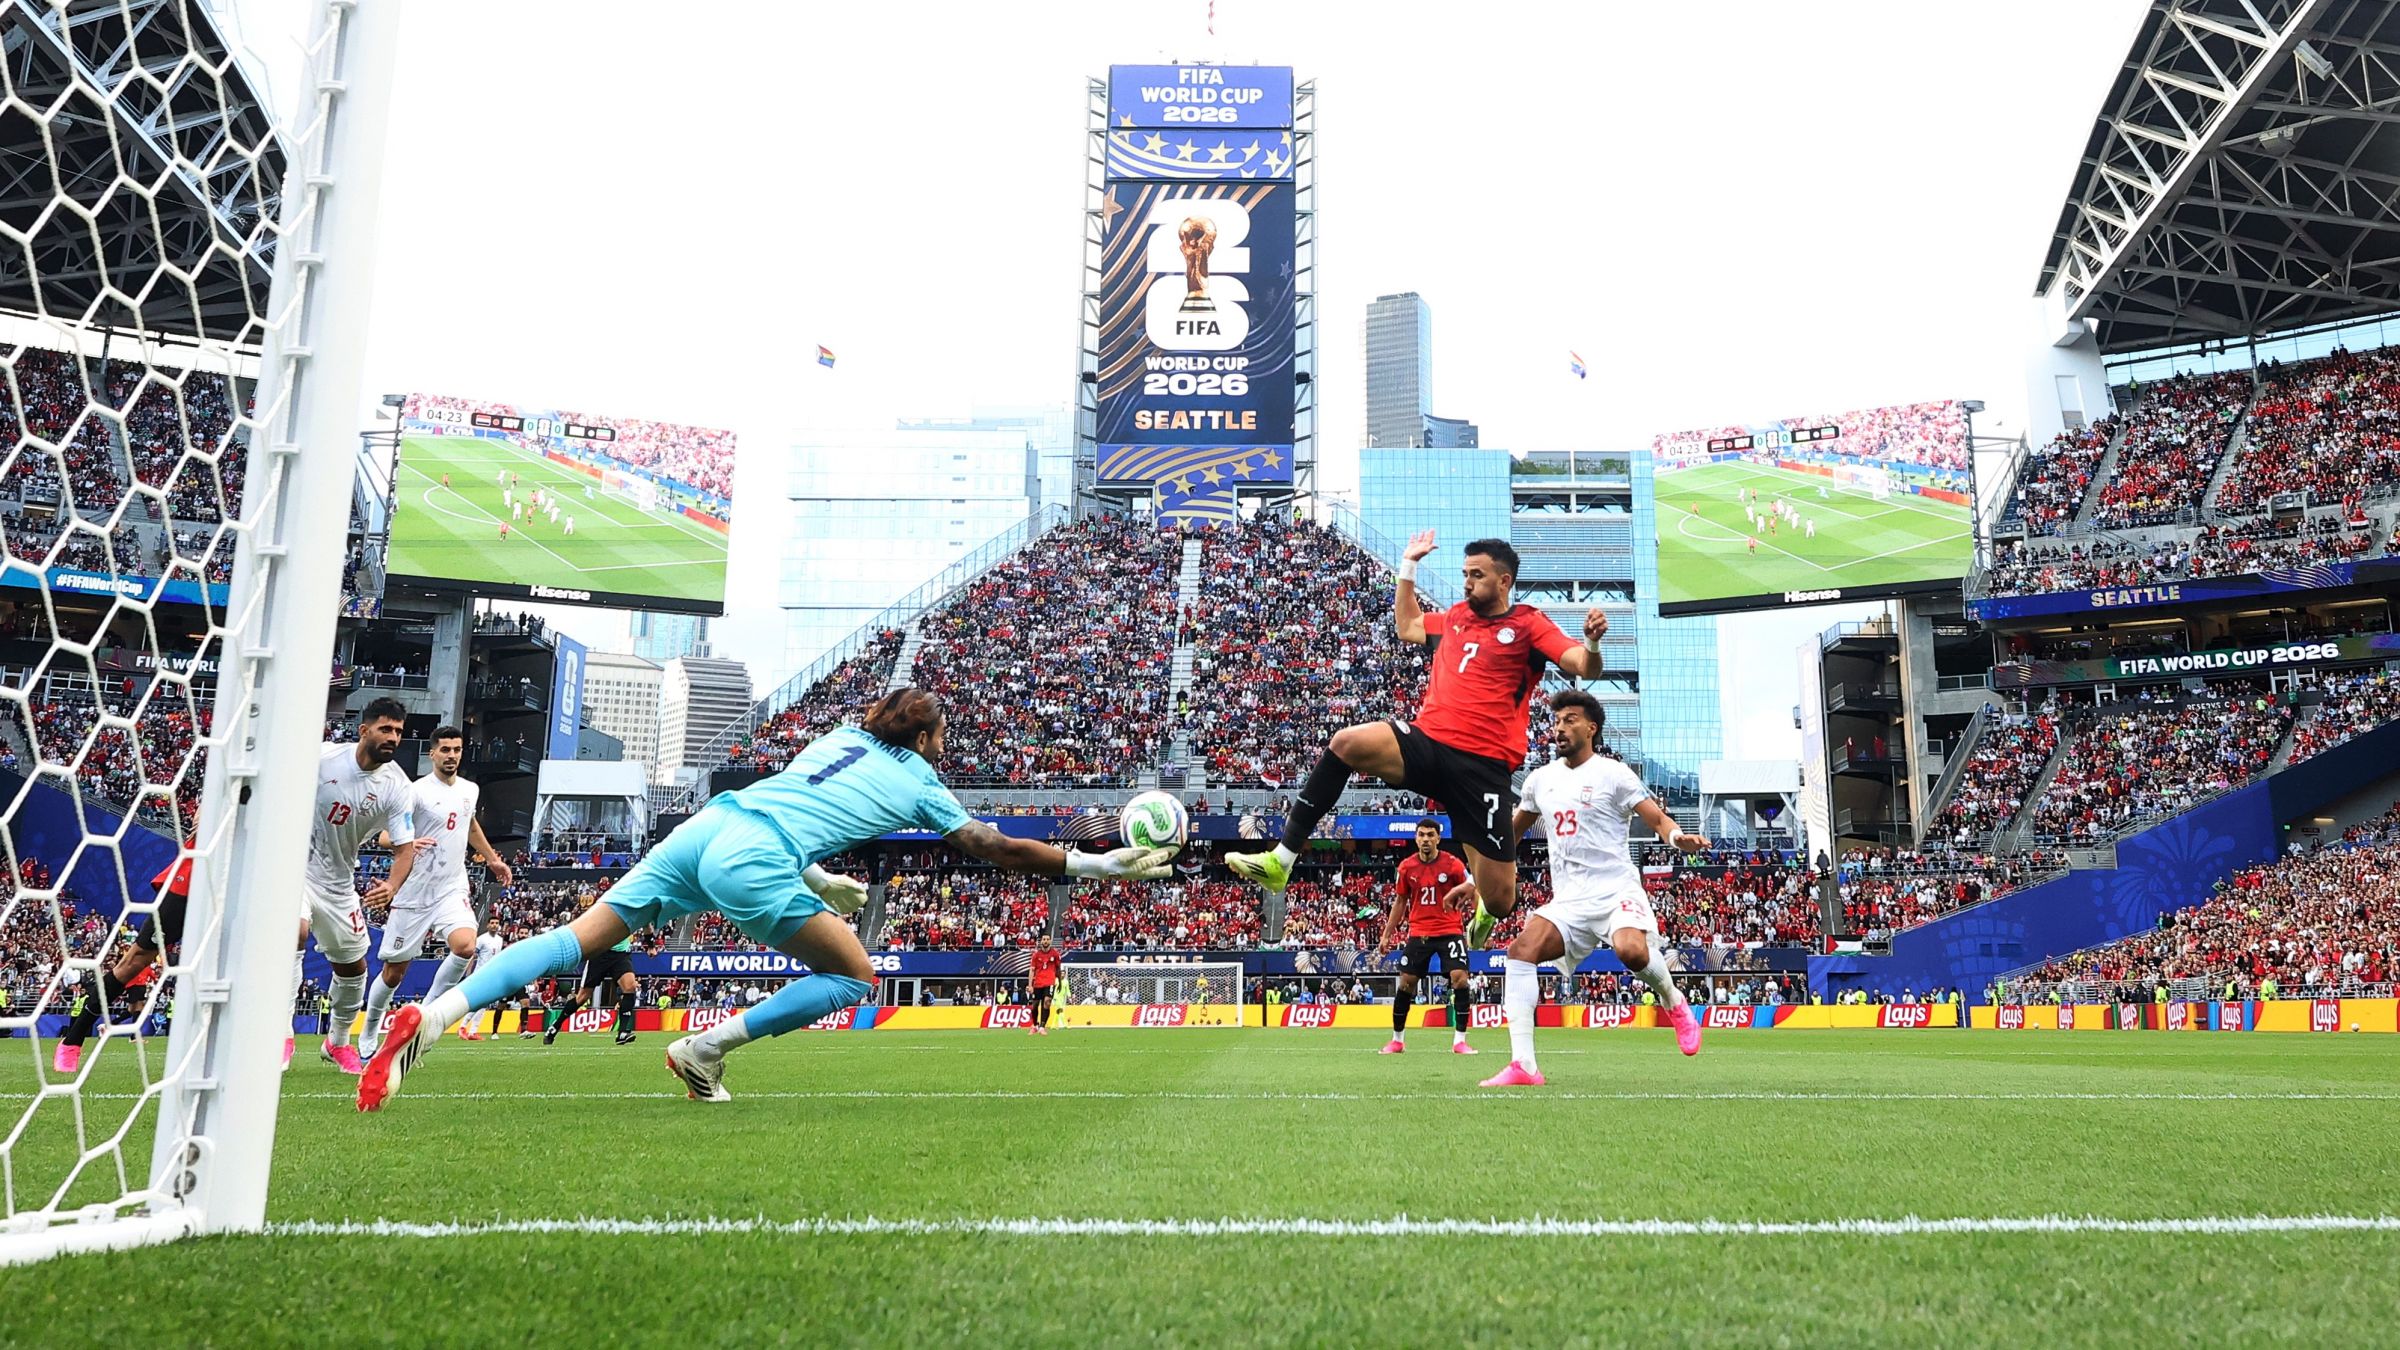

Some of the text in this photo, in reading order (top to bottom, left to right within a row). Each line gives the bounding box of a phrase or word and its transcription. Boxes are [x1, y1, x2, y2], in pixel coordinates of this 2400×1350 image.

[1179, 68, 1224, 84] FIFA
[1141, 87, 1263, 104] WORLD CUP
[1163, 106, 1238, 122] 2026
[1176, 320, 1221, 335] FIFA
[1144, 356, 1249, 371] WORLD CUP
[1144, 373, 1249, 396] 2026
[427, 409, 462, 423] 04:23
[527, 421, 534, 431] 0
[1134, 410, 1257, 430] SEATTLE
[554, 424, 561, 434] 0
[25, 486, 59, 498] 343
[2274, 494, 2303, 506] 301
[1994, 522, 2024, 534] 300
[530, 585, 591, 601] Hisense
[1784, 588, 1841, 603] Hisense
[2090, 585, 2181, 607] SEATTLE
[1458, 642, 1479, 673] 7
[2120, 643, 2339, 675] FIFA WORLD CUP 2026
[806, 746, 869, 786] 1
[326, 801, 351, 826] 13
[447, 812, 457, 831] 6
[1483, 793, 1499, 830] 7
[1554, 810, 1578, 837] 23
[1421, 886, 1437, 905] 21
[1448, 940, 1467, 959] 21
[671, 955, 714, 971] FIFA
[717, 955, 788, 971] WORLD
[988, 1004, 1032, 1027] Lay's
[1139, 1004, 1182, 1027] Lay's
[1288, 1004, 1331, 1027] Lay's
[1588, 1004, 1632, 1028] Lay's
[1709, 1004, 1749, 1028] Lay's
[1884, 1003, 1926, 1027] Lay's
[2000, 1005, 2023, 1029] Lay's
[2059, 1004, 2074, 1029] Lay's
[2221, 1001, 2241, 1031] Lay's
[2313, 1001, 2337, 1032] Lay's
